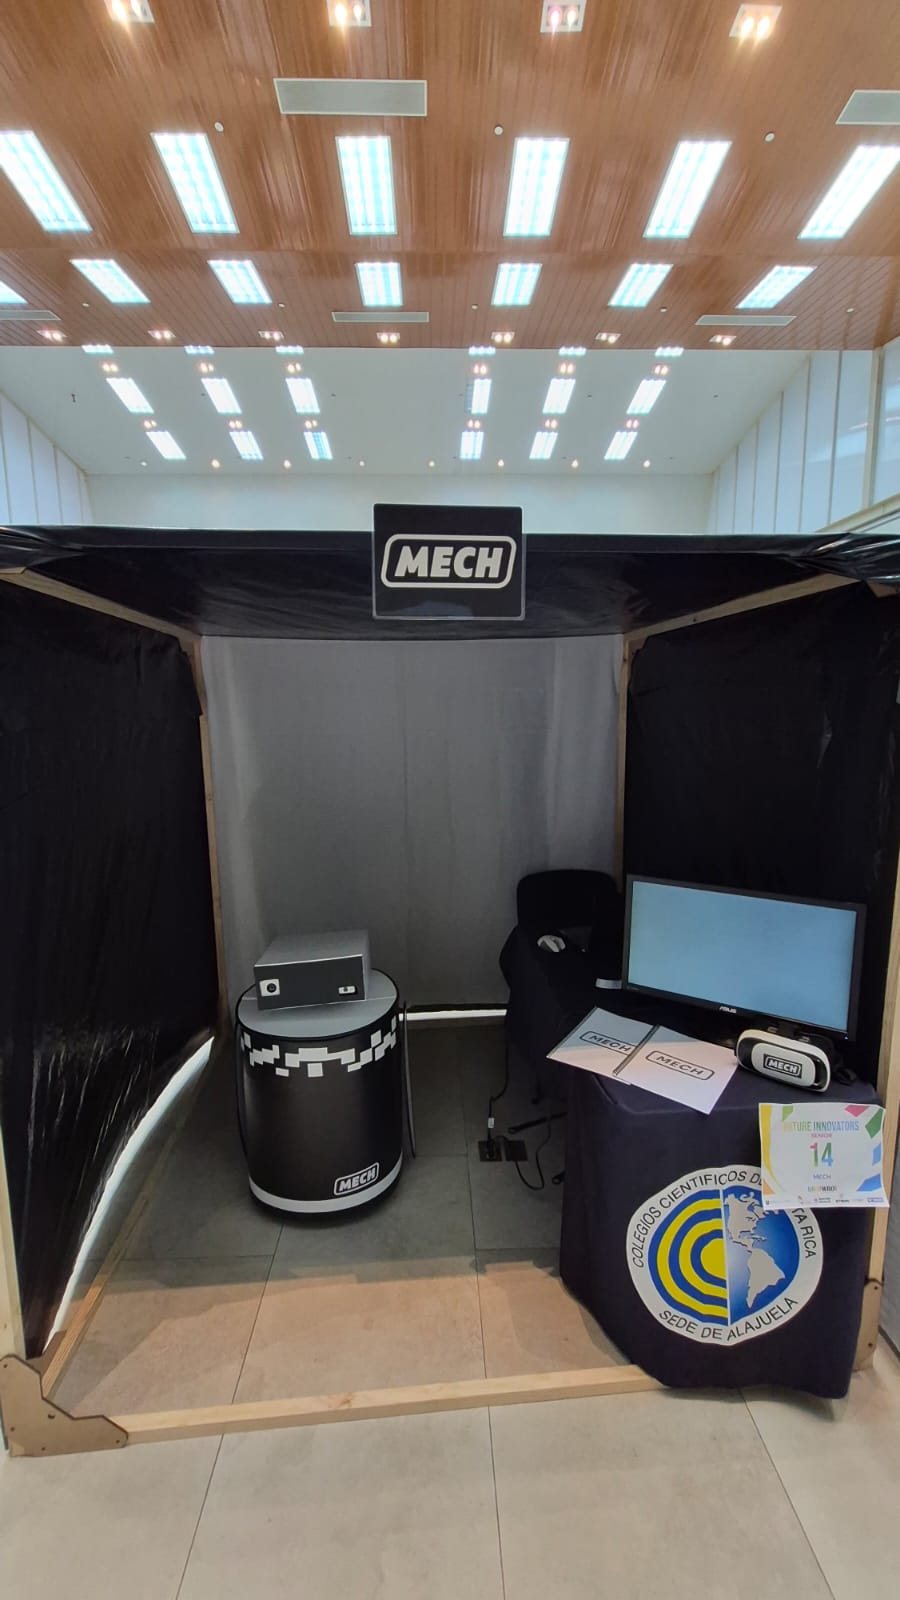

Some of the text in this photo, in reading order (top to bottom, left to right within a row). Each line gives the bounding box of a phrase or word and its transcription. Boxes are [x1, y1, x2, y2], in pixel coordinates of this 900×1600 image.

[394, 545, 504, 578] MECH
[588, 1034, 632, 1052] MECH
[656, 1056, 704, 1075] MECH
[768, 1059, 798, 1074] MECH
[784, 1120, 859, 1132] TURE INNOVATORS
[809, 1142, 834, 1167] 14
[338, 1167, 376, 1192] MECH
[632, 1206, 662, 1269] COLEGIOS
[659, 1170, 748, 1210] CIENTIFICOS
[800, 1225, 817, 1259] RICA
[659, 1296, 799, 1341] SEDE DE ALAJUELA
